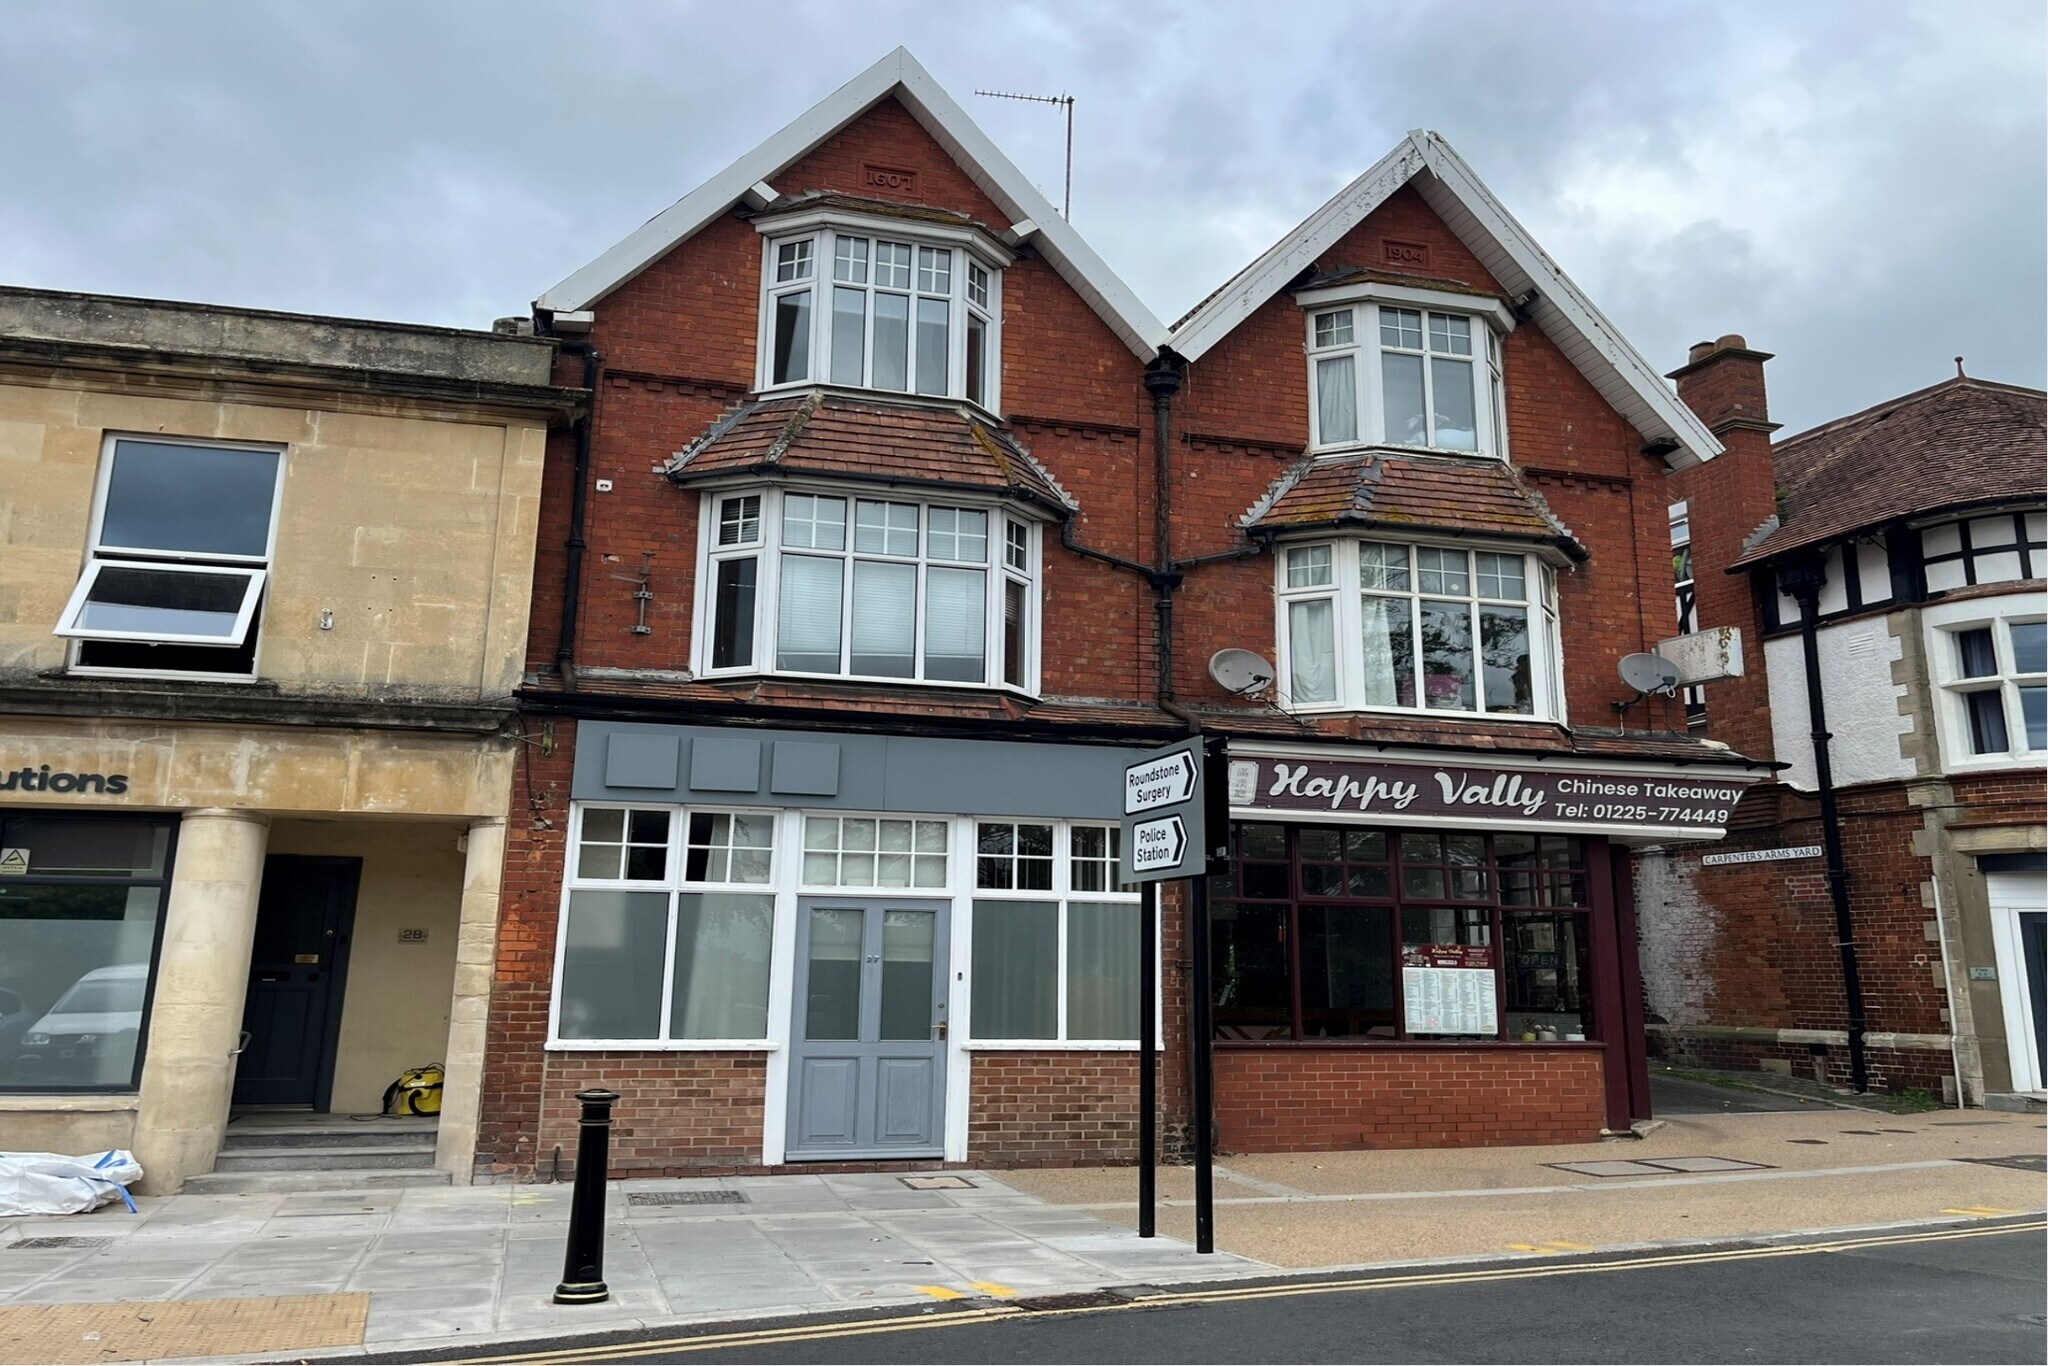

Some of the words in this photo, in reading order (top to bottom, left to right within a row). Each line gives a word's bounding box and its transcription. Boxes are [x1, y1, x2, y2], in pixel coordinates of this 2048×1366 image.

[1385, 246, 1423, 263] 1904
[1129, 764, 1180, 788] Roundstone
[1136, 785, 1171, 803] Surgery
[1269, 763, 1419, 810] Happy
[1434, 771, 1548, 816] Vally
[1557, 779, 1638, 796] Chinese
[1643, 783, 1743, 805] Takeaway
[1555, 803, 1588, 818] Tel:
[1593, 804, 1728, 823] 01225-774449
[1140, 828, 1166, 844] Police
[1137, 846, 1169, 862] Station
[1705, 852, 1762, 864] CARPENTERS
[1764, 849, 1790, 859] ARMS
[1792, 847, 1820, 857] YARD
[403, 929, 423, 939] 28
[866, 955, 880, 963] 27
[1522, 955, 1559, 965] OPEN
